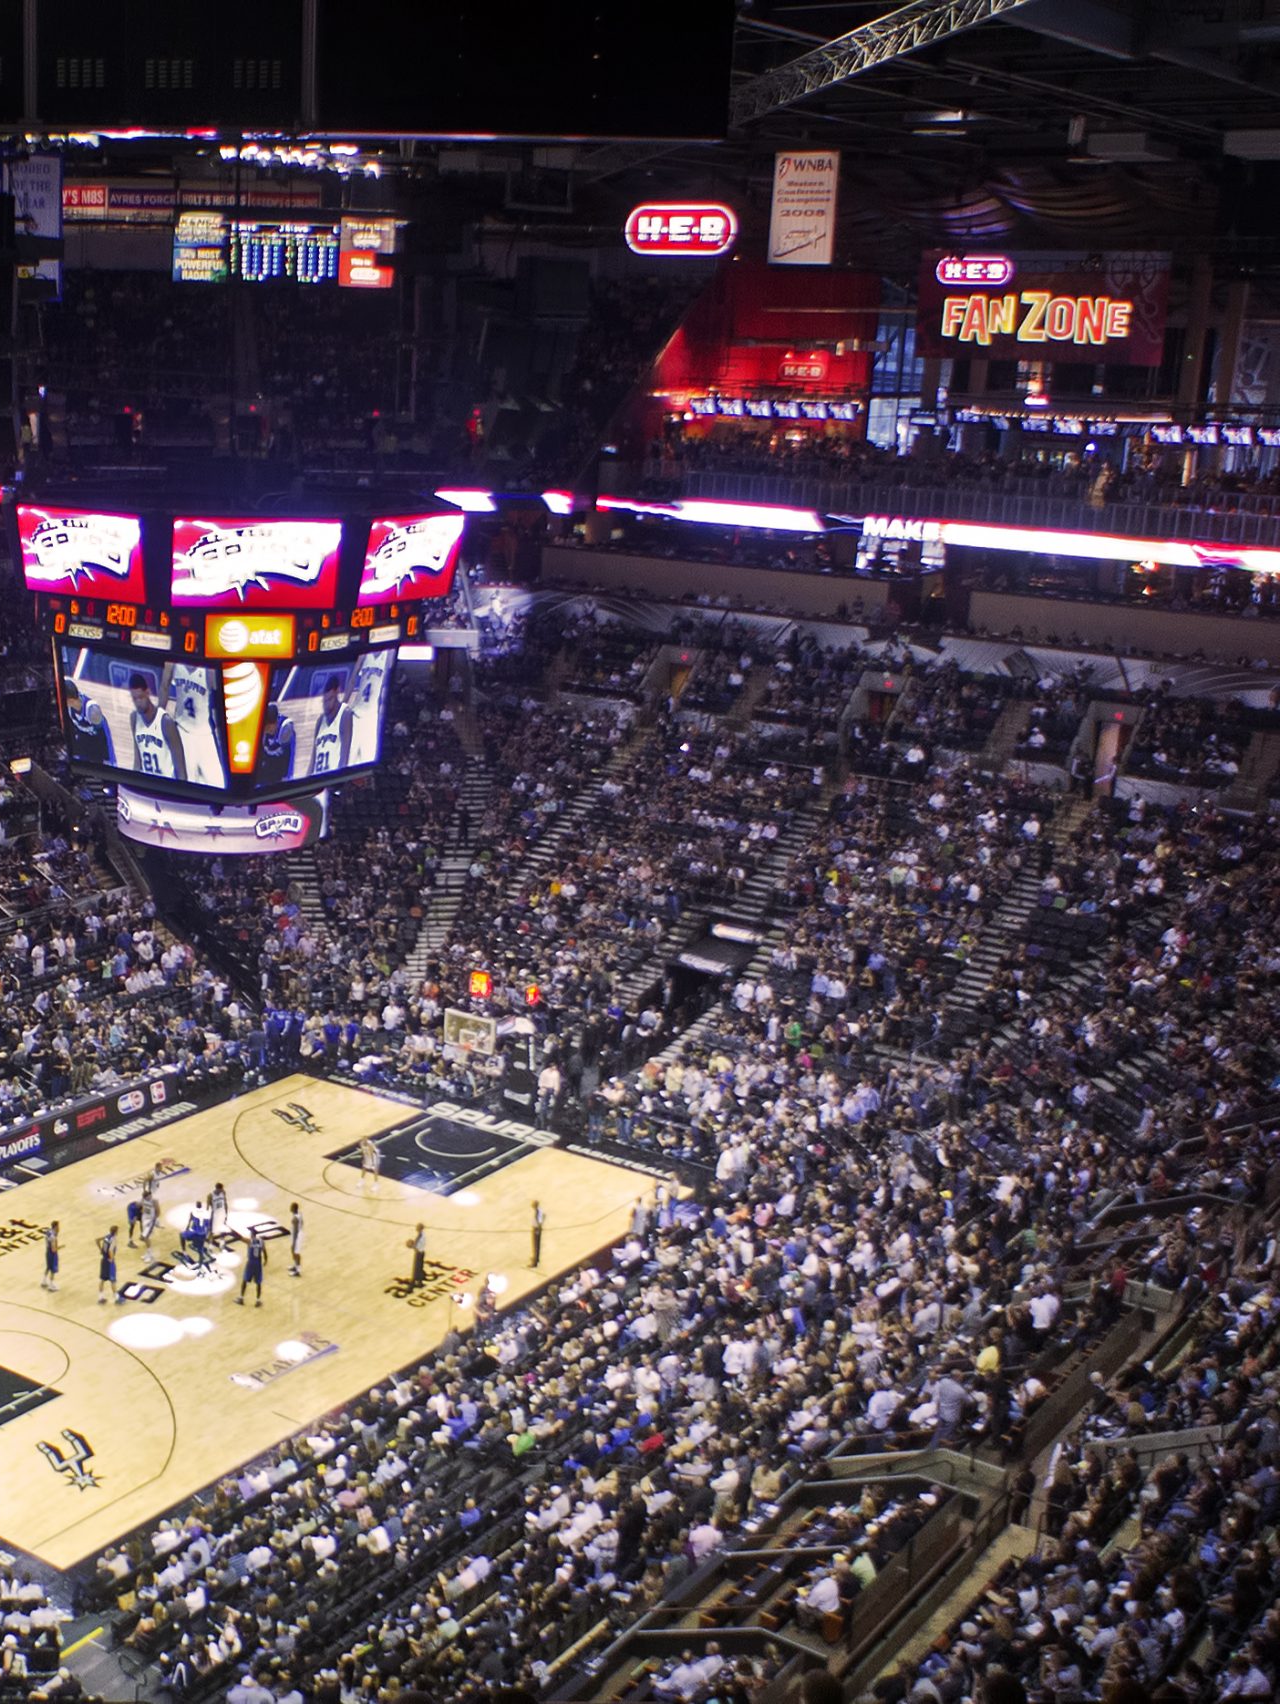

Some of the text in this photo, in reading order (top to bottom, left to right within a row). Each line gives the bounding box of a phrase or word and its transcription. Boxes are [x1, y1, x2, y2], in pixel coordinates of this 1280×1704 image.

[794, 158, 833, 172] WNBA
[780, 209, 826, 217] 2008
[941, 291, 1133, 346] FAN ZONE
[863, 516, 944, 541] MAKE
[107, 604, 137, 627] 12:00
[351, 607, 375, 628] 12:00
[362, 682, 372, 703] 4
[184, 697, 196, 718] 4
[143, 751, 162, 774] 21
[316, 752, 329, 772] 21
[76, 1106, 106, 1129] ESPN
[97, 1101, 197, 1143] spurs.com
[426, 1101, 561, 1147] SPURS
[407, 1269, 480, 1307] CENTER
